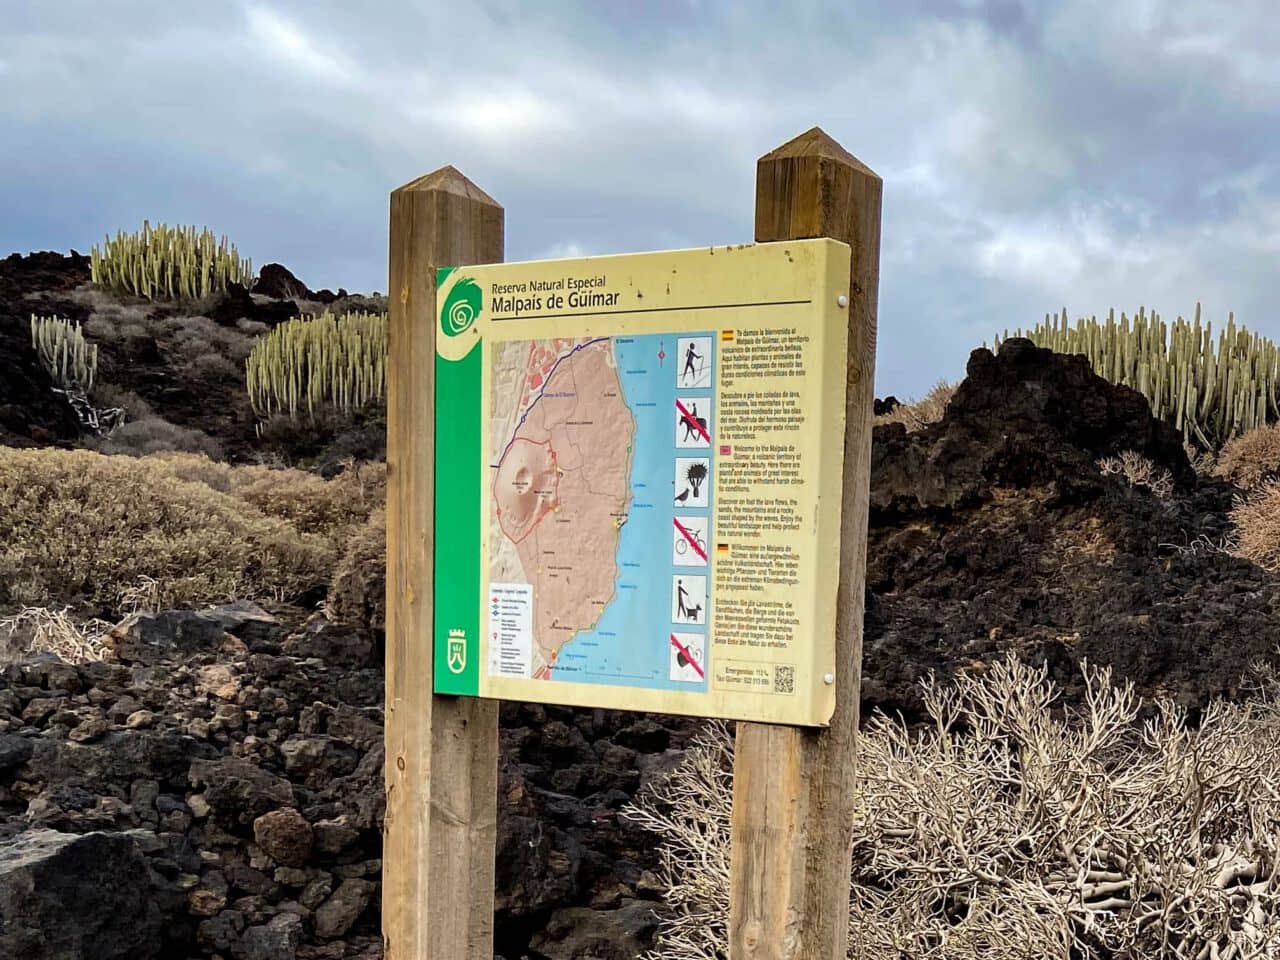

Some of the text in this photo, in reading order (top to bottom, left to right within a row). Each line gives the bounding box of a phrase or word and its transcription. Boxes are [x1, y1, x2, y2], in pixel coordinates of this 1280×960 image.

[492, 275, 606, 294] Reserva Natural Especial
[491, 290, 620, 316] Malpaís de Güímar
